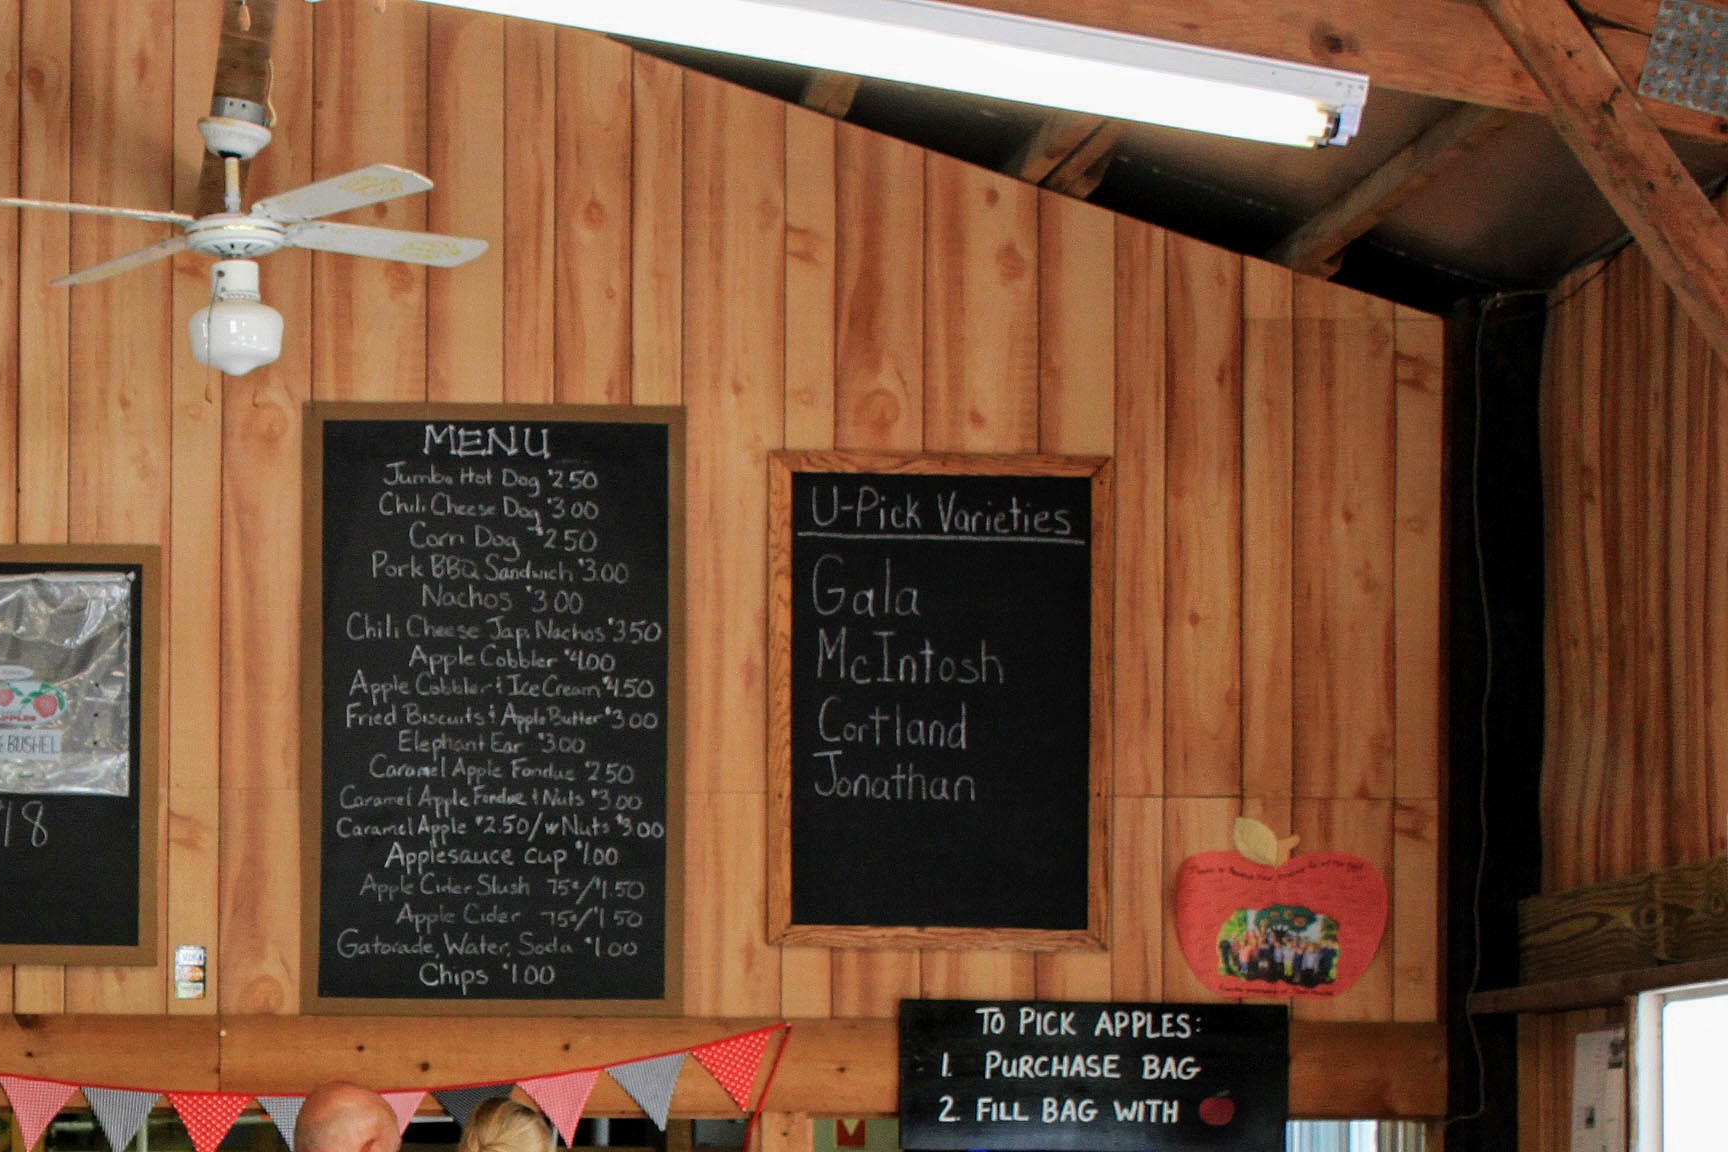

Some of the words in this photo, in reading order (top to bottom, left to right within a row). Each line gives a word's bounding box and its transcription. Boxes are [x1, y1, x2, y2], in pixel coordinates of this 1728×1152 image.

[423, 424, 551, 459] MENU
[383, 461, 453, 486] Jumbo
[460, 467, 493, 485] Hot
[502, 468, 540, 497] Dog
[379, 491, 425, 516] Chili
[431, 492, 495, 516] Cheese
[503, 496, 542, 530] Dog
[811, 485, 922, 528] U-Pick
[937, 491, 1072, 535] Varieties
[409, 521, 464, 548] Corn
[474, 525, 520, 561] Dog
[372, 551, 423, 578] Pork
[431, 554, 479, 579] BBQ
[485, 553, 573, 581] Sandwich
[422, 583, 512, 611] Nachos
[813, 554, 921, 617] Gala
[346, 612, 399, 640] Chili
[406, 615, 479, 639] Cheese
[536, 619, 605, 642] Nachos
[409, 645, 475, 675] Apple
[480, 644, 558, 668] Cobbler
[817, 627, 1004, 684] McIntosh
[349, 669, 410, 706] Apple
[415, 671, 493, 695] Cobbler
[346, 702, 397, 728] Fried
[402, 703, 485, 726] Biscuits
[500, 702, 545, 733] Apple
[546, 706, 603, 726] Butter
[819, 695, 967, 750] Cortland
[7, 734, 59, 754] BUSHEL
[398, 729, 485, 762] Elephant
[491, 731, 523, 753] Ear
[369, 753, 446, 778] Caramel
[452, 757, 503, 785] Apple
[511, 757, 576, 781] Fondue
[813, 750, 976, 801] Jonathan
[340, 784, 412, 809] Caramel
[418, 784, 470, 818] Apple
[474, 785, 527, 806] Fondue
[543, 788, 585, 806] Nuts
[337, 816, 413, 838] Caramel
[418, 814, 467, 848] Apple
[562, 814, 610, 837] Nuts
[384, 841, 514, 875] Applesauce
[524, 848, 567, 875] Cup
[360, 873, 414, 902] Apple
[420, 872, 472, 895] Cider
[476, 874, 530, 896] Slush
[397, 903, 456, 935] Apple
[464, 903, 521, 924] Cider
[337, 928, 441, 959] Gatorade,
[519, 932, 571, 955] Soda
[419, 962, 489, 995] Chips
[976, 1006, 1006, 1036] TO
[1019, 1006, 1077, 1036] PICK
[1094, 1010, 1203, 1039] APPLES:
[984, 1050, 1121, 1080] PURCHASE
[1142, 1055, 1202, 1081] BAG
[938, 1095, 961, 1122] 2.
[976, 1097, 1029, 1122] FILL
[1042, 1098, 1098, 1123] BAG
[1113, 1099, 1179, 1124] WITH
